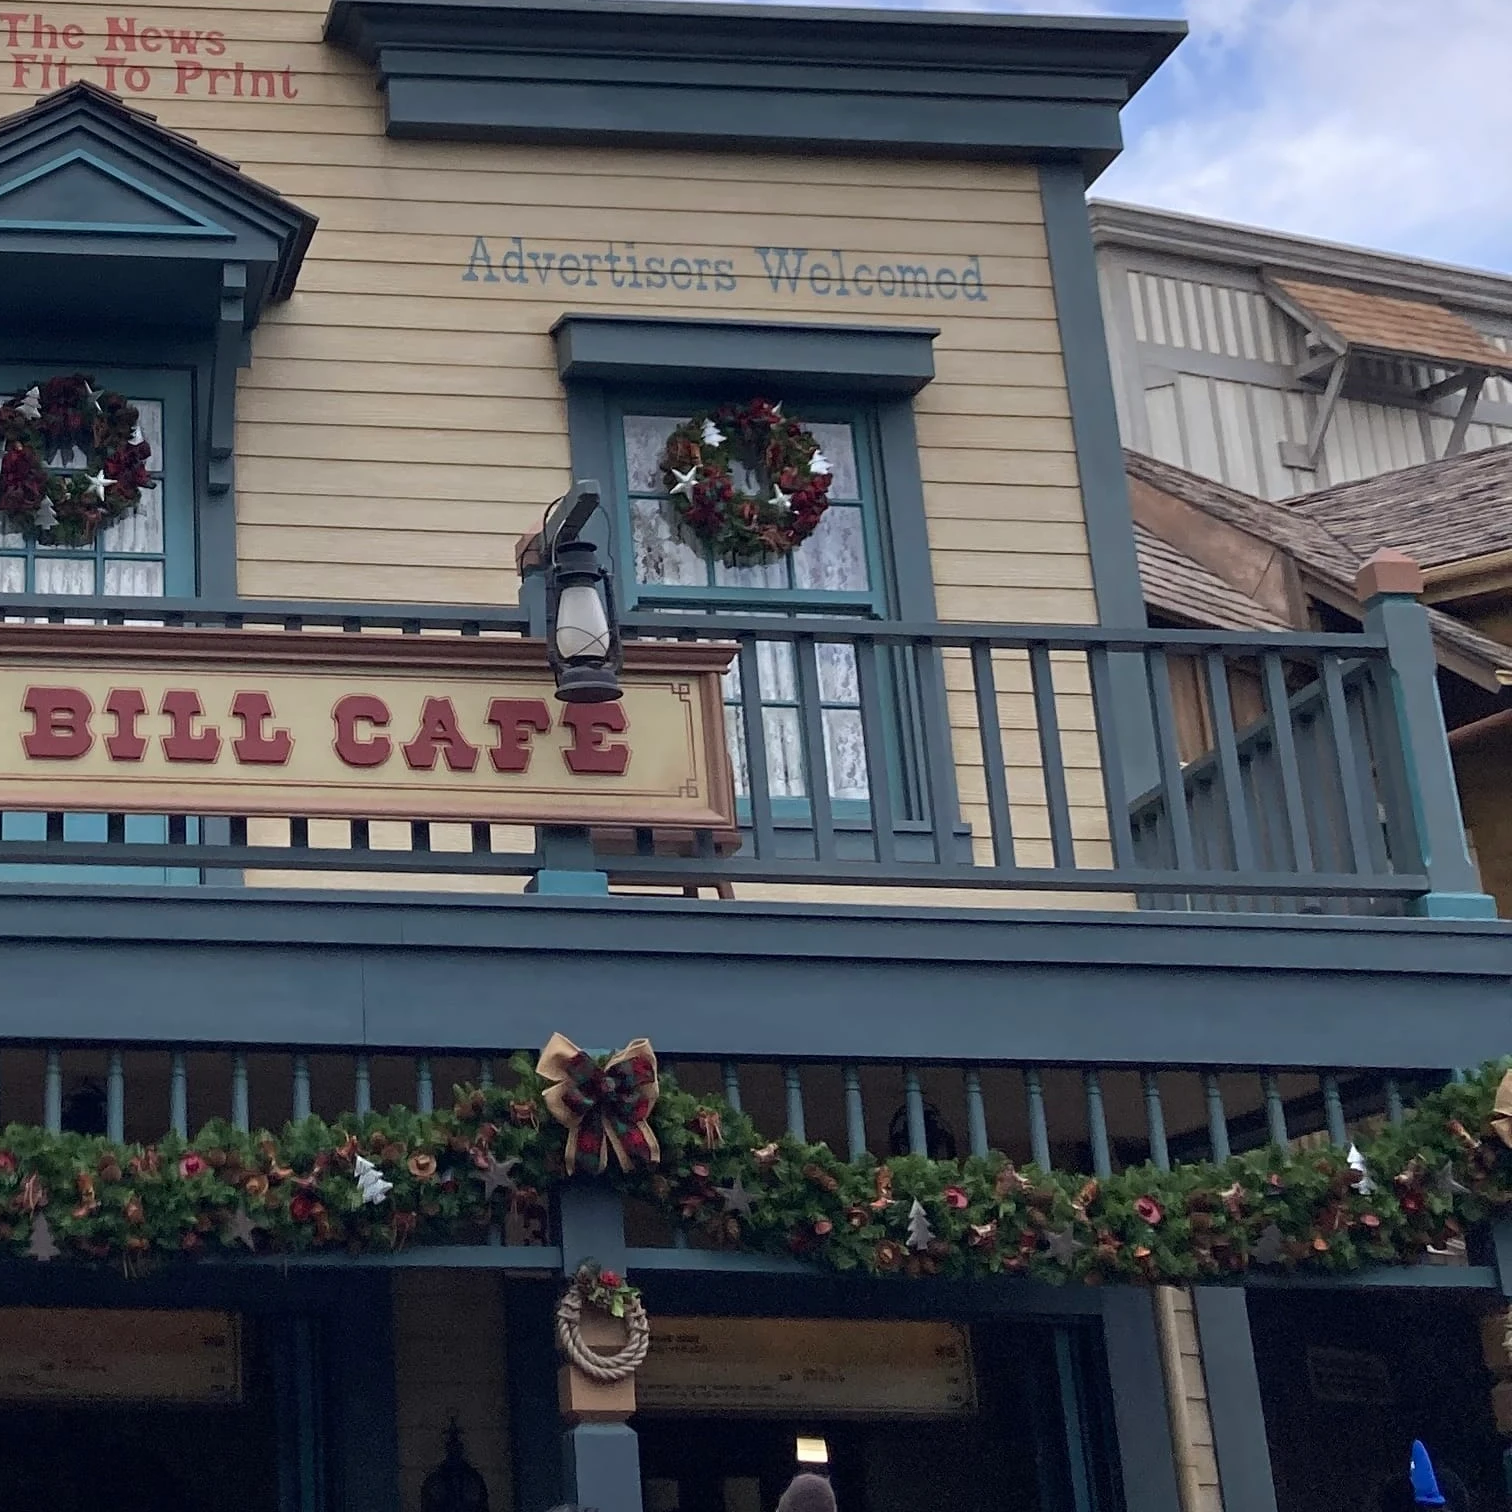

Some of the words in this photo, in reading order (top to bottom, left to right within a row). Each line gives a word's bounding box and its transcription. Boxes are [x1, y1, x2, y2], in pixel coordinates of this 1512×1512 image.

[104, 16, 227, 56] News
[95, 56, 151, 92] To
[174, 60, 299, 99] Print
[461, 236, 737, 292] Advertisers
[753, 246, 988, 302] Welcomed
[20, 685, 295, 765] BILL
[331, 693, 633, 776] CAFE
